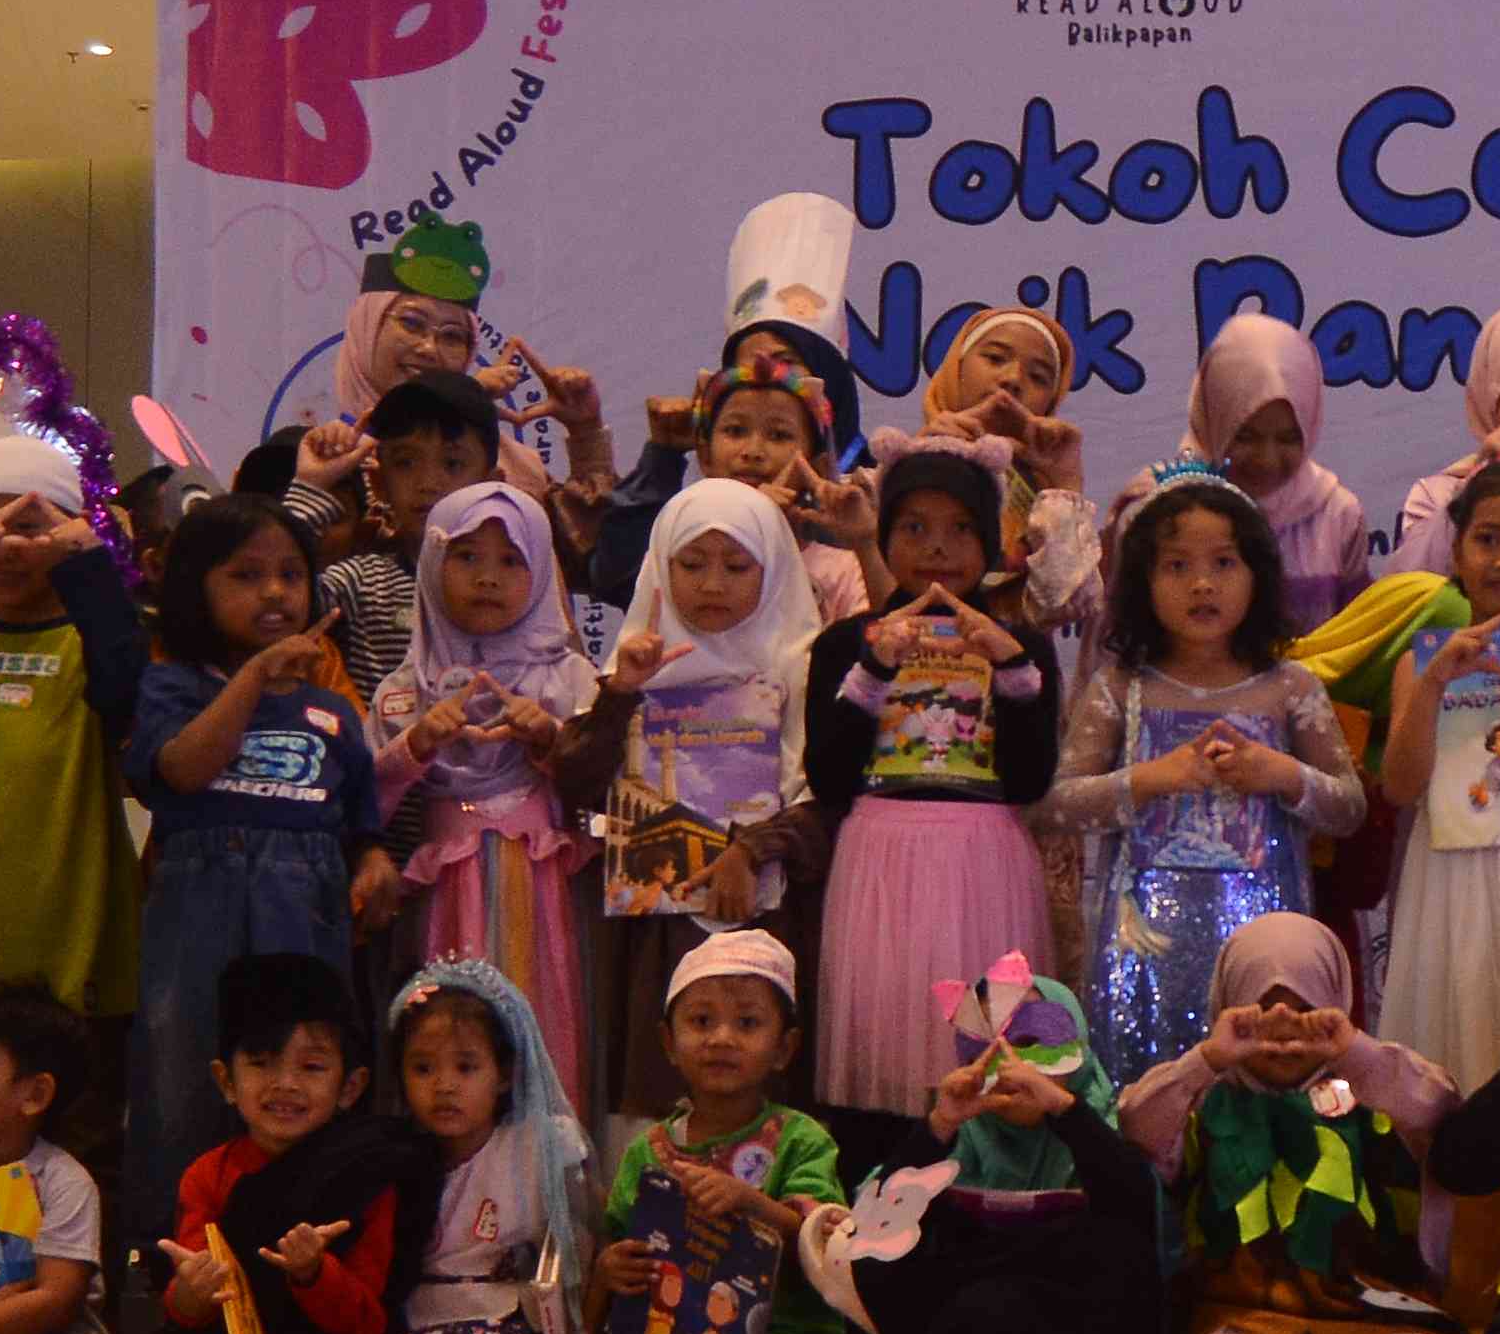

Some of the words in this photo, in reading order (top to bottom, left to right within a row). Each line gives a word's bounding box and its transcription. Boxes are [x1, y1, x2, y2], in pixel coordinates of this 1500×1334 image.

[1067, 22, 1192, 48] Balikpapan
[350, 170, 454, 250] Read
[457, 67, 545, 187] Aloud
[821, 85, 1290, 229] Tokoh
